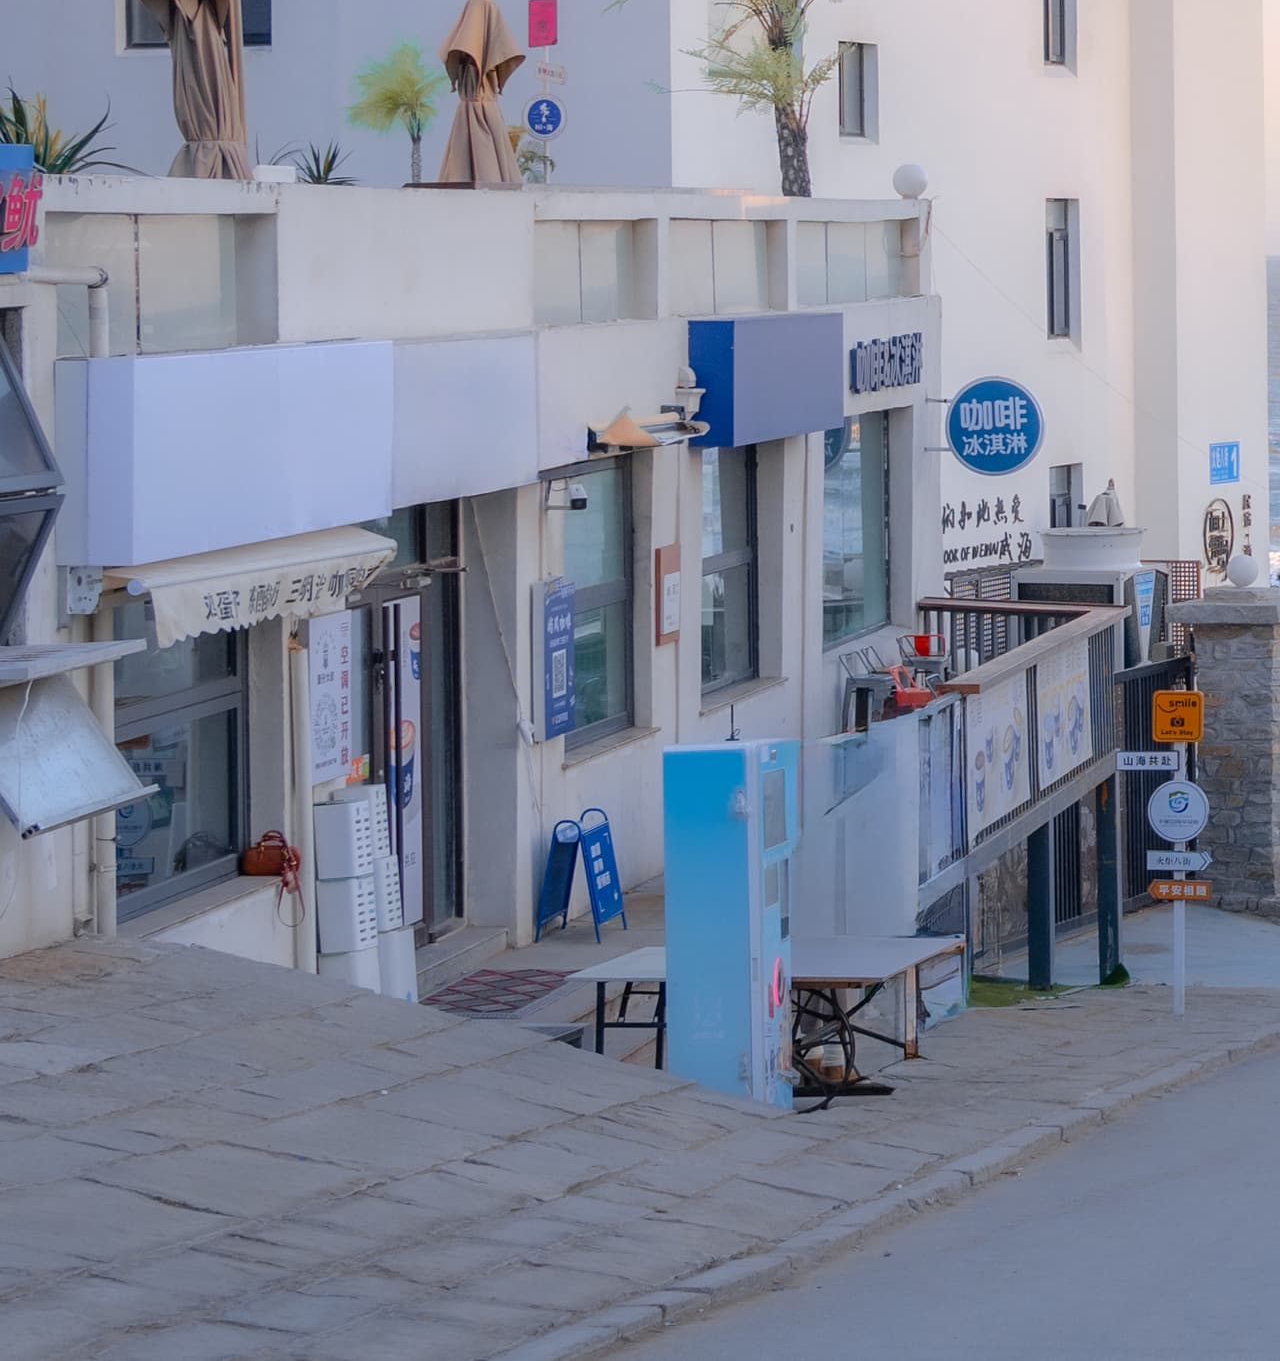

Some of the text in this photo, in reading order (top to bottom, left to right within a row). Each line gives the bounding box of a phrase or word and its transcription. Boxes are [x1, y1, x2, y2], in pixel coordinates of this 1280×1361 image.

[0, 170, 43, 252] 鱿
[960, 396, 1028, 431] 咖啡
[962, 433, 1027, 456] 冰淇淋
[1169, 697, 1197, 708] smile
[1123, 755, 1172, 767] 山海共赴
